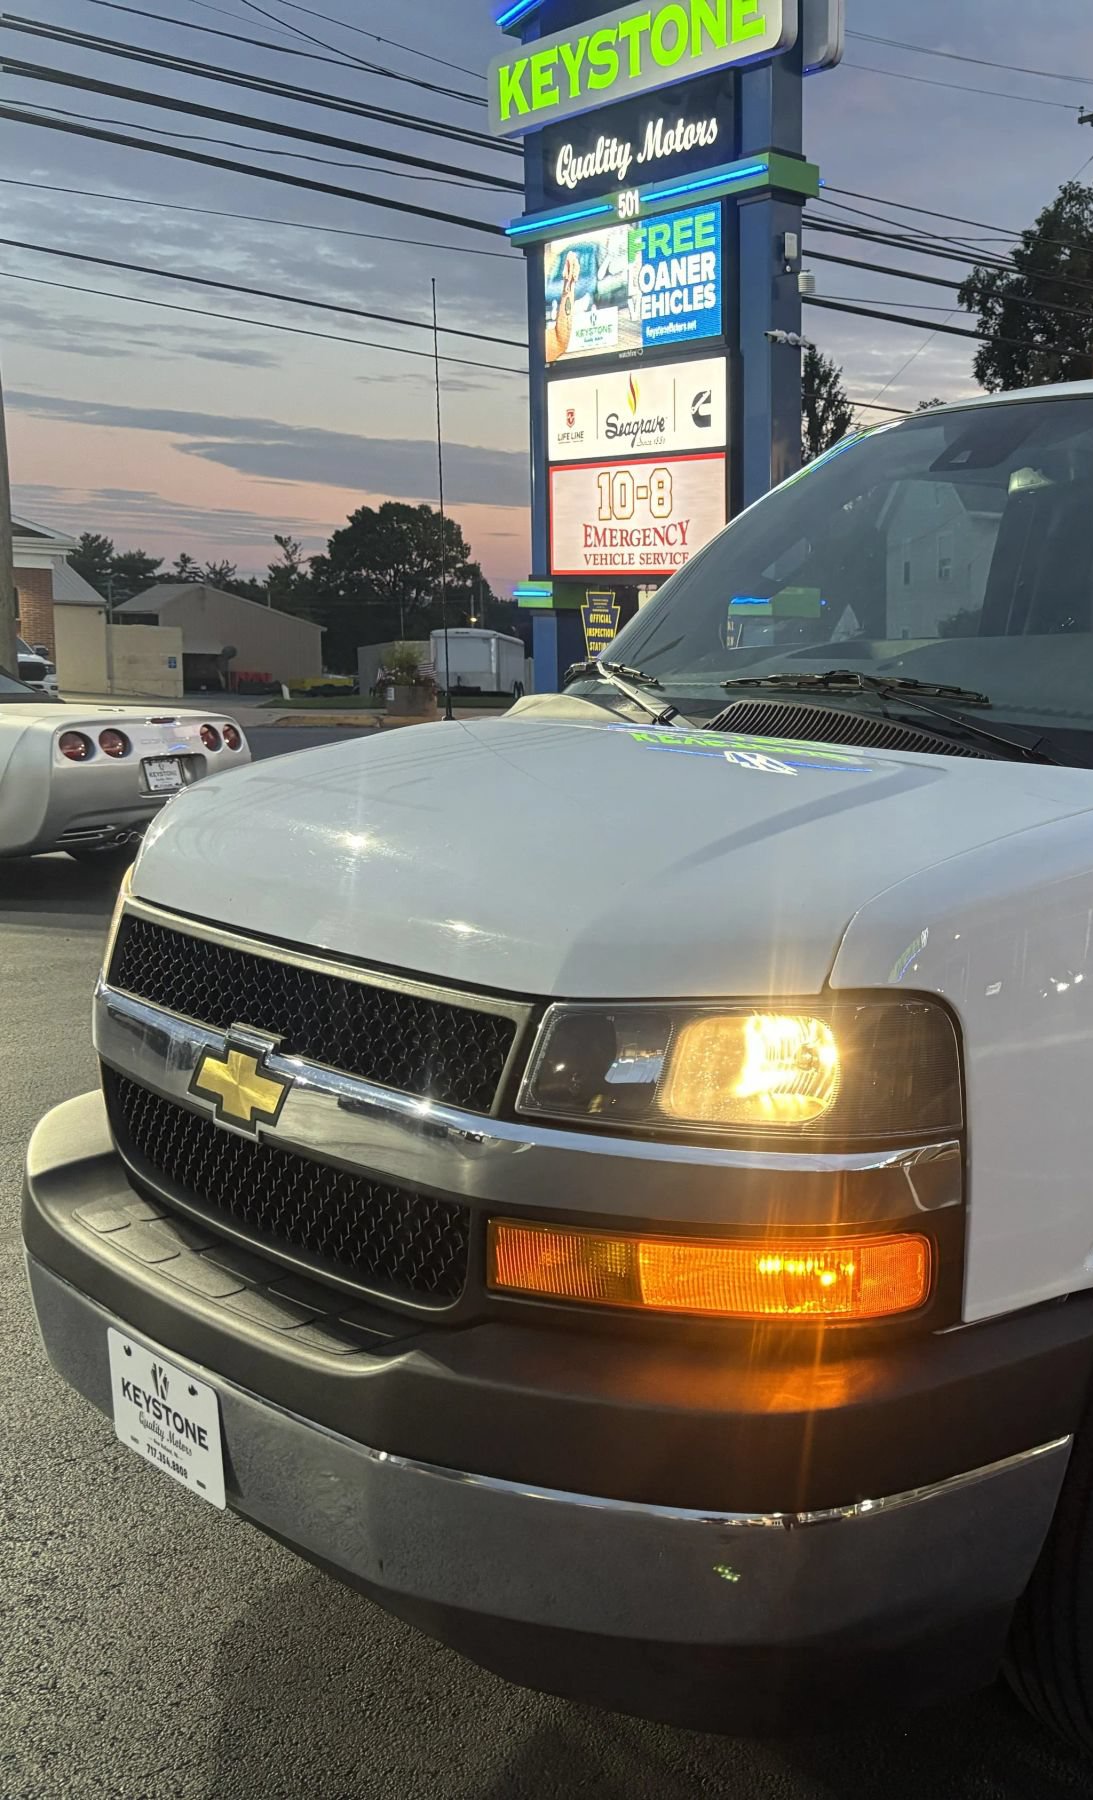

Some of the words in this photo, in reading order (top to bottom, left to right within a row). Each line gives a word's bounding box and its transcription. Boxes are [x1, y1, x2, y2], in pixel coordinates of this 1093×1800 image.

[498, 0, 766, 121] KEYSTONE
[555, 136, 633, 189] Quality
[637, 117, 719, 164] Motors
[617, 189, 640, 219] 501
[627, 211, 716, 263] FREE
[628, 251, 716, 297] LOANER
[628, 282, 717, 321] VEHICLES
[605, 413, 665, 448] Seagrave
[597, 468, 673, 521] 10-8
[582, 519, 690, 548] EMERGENCY
[583, 552, 635, 566] VEHICLE
[586, 627, 614, 638] INSPECTION
[589, 613, 612, 625] OFFICIAL
[589, 641, 609, 652] STATIO
[121, 1376, 209, 1452] KEYSTONE
[138, 1410, 165, 1442] Quality
[166, 1430, 192, 1457] Motors
